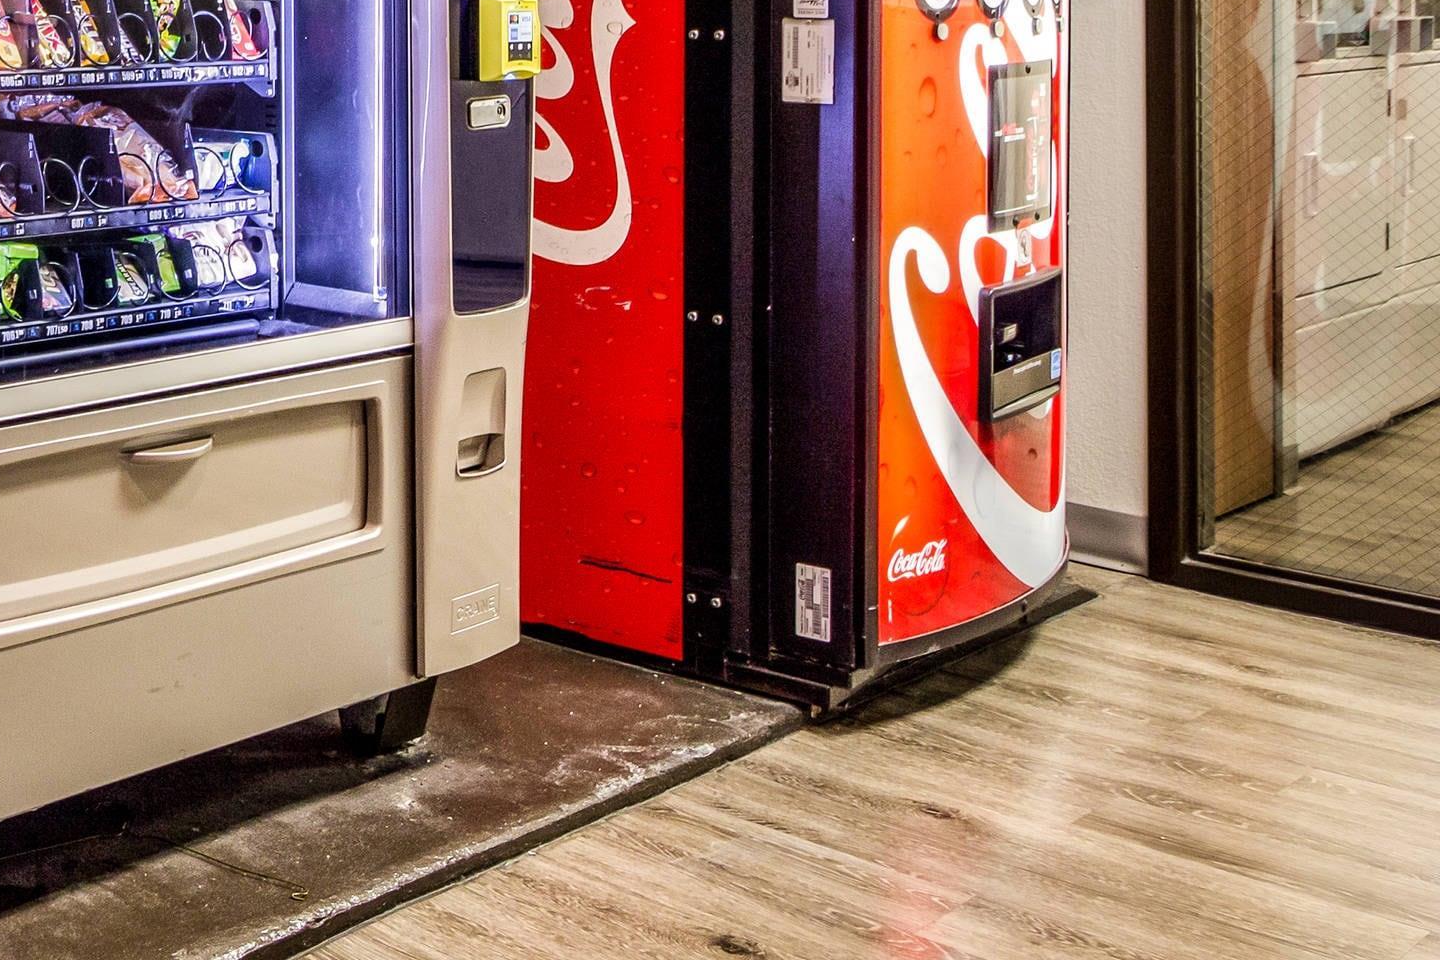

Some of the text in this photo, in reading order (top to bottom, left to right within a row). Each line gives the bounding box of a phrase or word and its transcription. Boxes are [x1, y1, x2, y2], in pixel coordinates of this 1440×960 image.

[42, 74, 55, 86] 507
[46, 325, 57, 336] 707
[888, 541, 948, 582] Coca-Cola
[456, 595, 496, 622] CRANE
